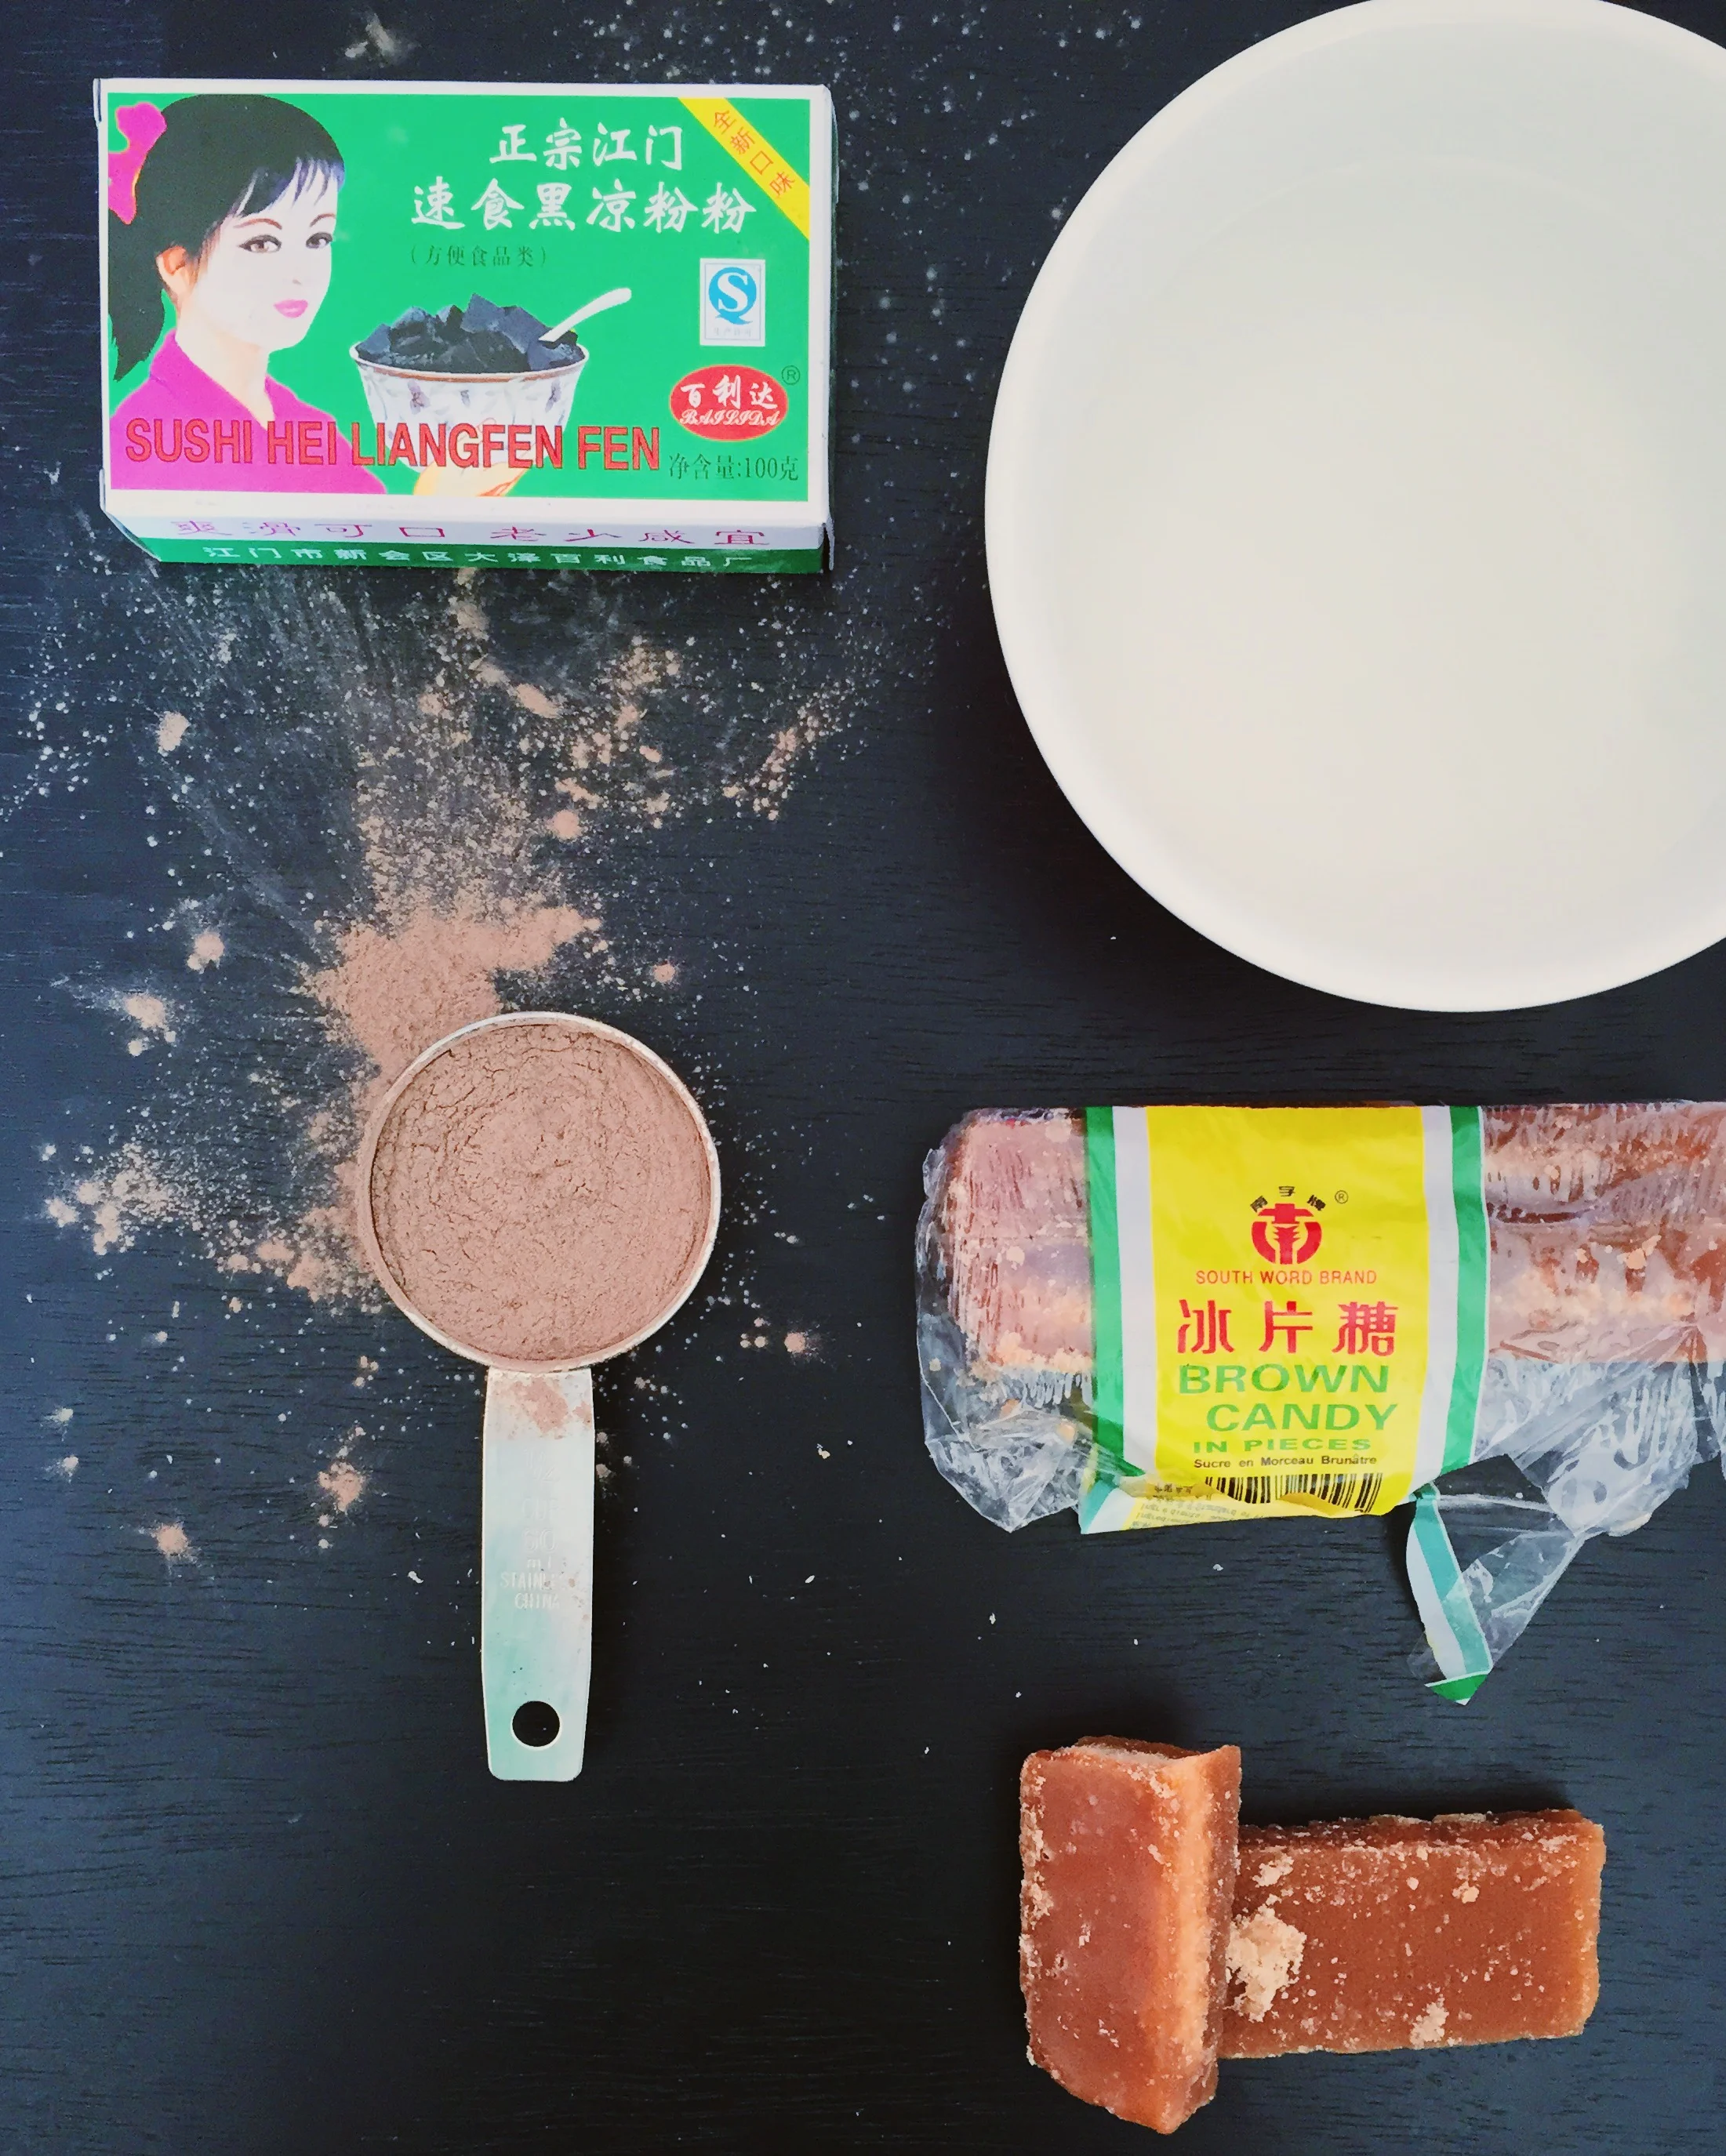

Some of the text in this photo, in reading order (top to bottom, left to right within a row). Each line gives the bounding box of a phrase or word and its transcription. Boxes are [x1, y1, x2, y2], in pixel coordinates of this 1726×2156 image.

[489, 118, 683, 171] 正宗江门
[714, 110, 796, 199] 全新口味
[411, 176, 757, 234] 速食黑凉粉粉
[680, 374, 779, 410] 百利达
[679, 408, 780, 426] BAILIDA
[125, 418, 660, 471] SUSHI HEI LIANGFEN FEN
[1196, 1270, 1377, 1285] SOUTH WORD BRAND
[1177, 1299, 1399, 1356] 冰片糖
[1179, 1363, 1390, 1395] BROWN
[1206, 1403, 1398, 1432] CANDY
[1194, 1437, 1372, 1454] IN PIECES
[1194, 1459, 1231, 1468] Sucre
[1261, 1457, 1314, 1466] Morceau
[1321, 1454, 1377, 1465] Brunâtre
